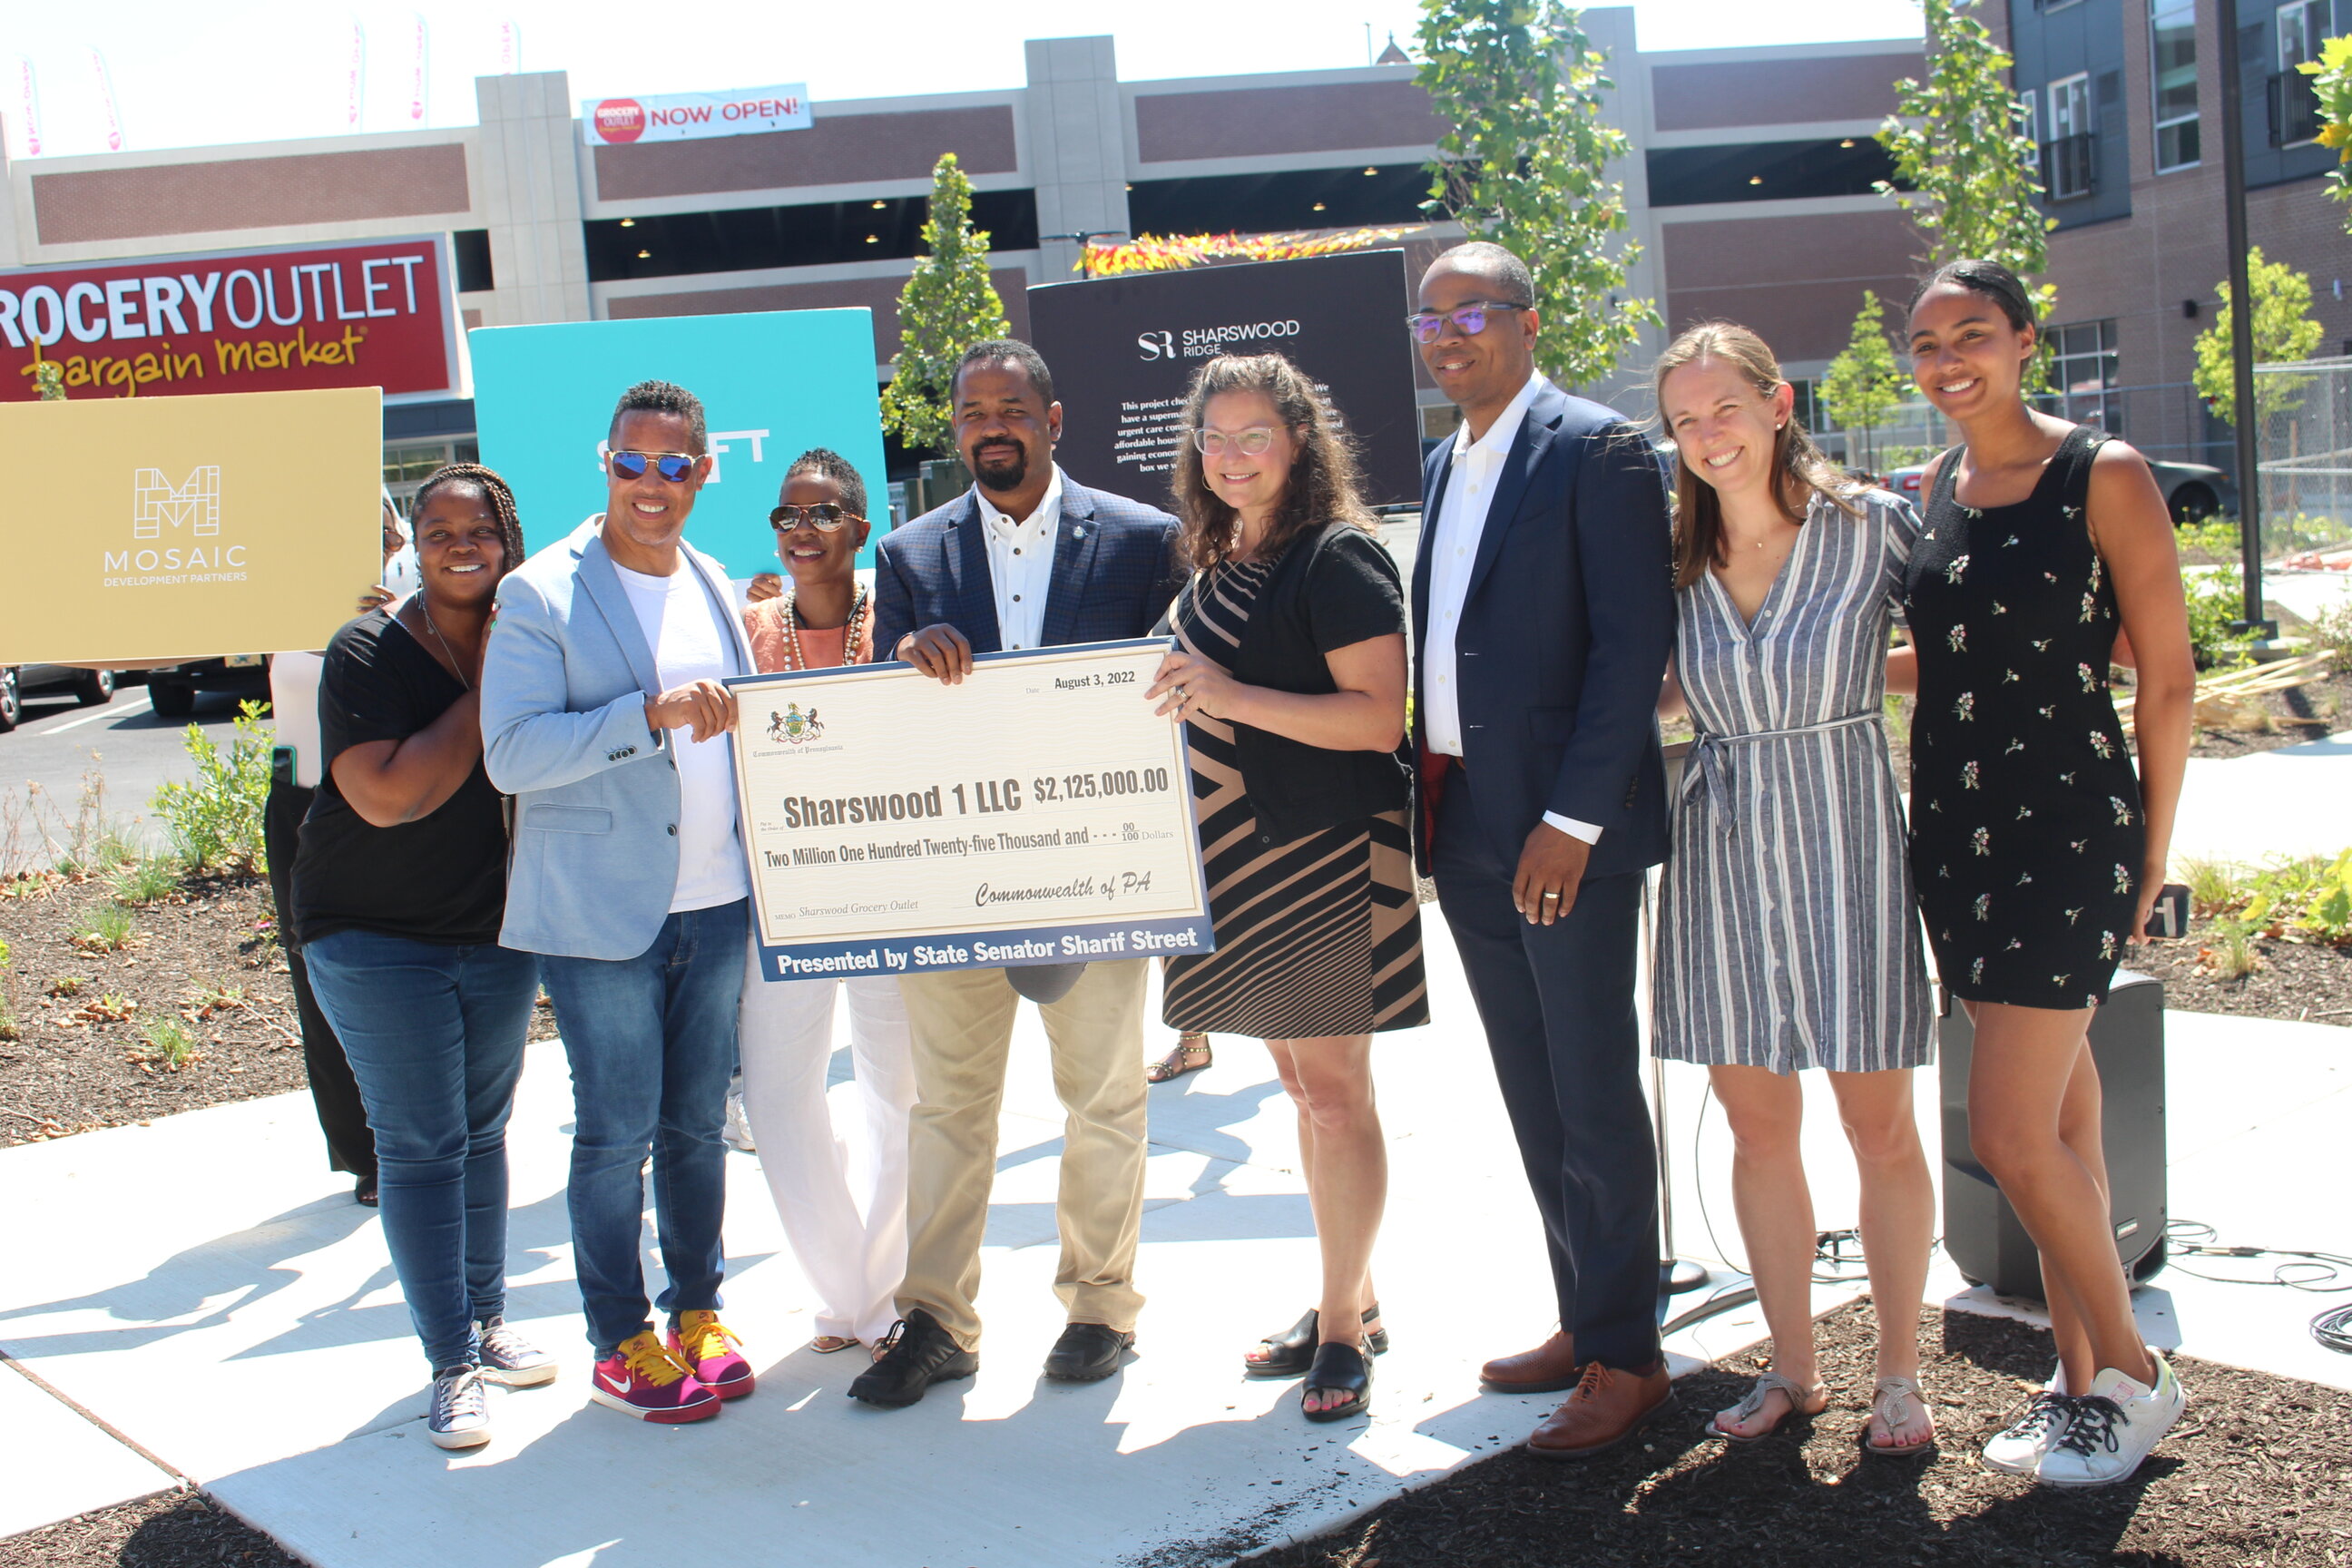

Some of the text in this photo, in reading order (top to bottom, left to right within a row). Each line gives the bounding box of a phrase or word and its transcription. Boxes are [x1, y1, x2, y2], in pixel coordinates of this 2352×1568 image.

[651, 98, 799, 126] NOW OPEN!
[1182, 319, 1300, 346] SHARSWOOD
[1183, 343, 1221, 358] RIDGE
[20, 325, 364, 397] bargain market
[1122, 401, 1139, 411] This
[1140, 398, 1169, 411] project
[1121, 415, 1141, 424] have
[1117, 426, 1143, 437] urgent
[1145, 426, 1163, 434] care
[1113, 437, 1156, 449] affordable
[1116, 451, 1147, 464] gaining
[1139, 464, 1155, 472] box
[104, 545, 247, 573] MOSAIC
[103, 572, 247, 587] DEVELOPMENT PARTNERS
[1054, 675, 1091, 690] August
[1093, 674, 1104, 687] 3,
[1107, 671, 1135, 684] 2022
[783, 767, 1169, 828] Sharswood 1 LLC $2,125,000.00
[764, 822, 1174, 867] Two Million One Hundred Twenty-five Thousand and 00 100 Dollars
[975, 870, 1152, 906] Commonwealth of PA
[799, 904, 848, 917] Sharswood
[850, 902, 888, 915] Grocery
[890, 899, 918, 911] Outlet
[778, 927, 1198, 975] Presented by State Senator Sharif Street
